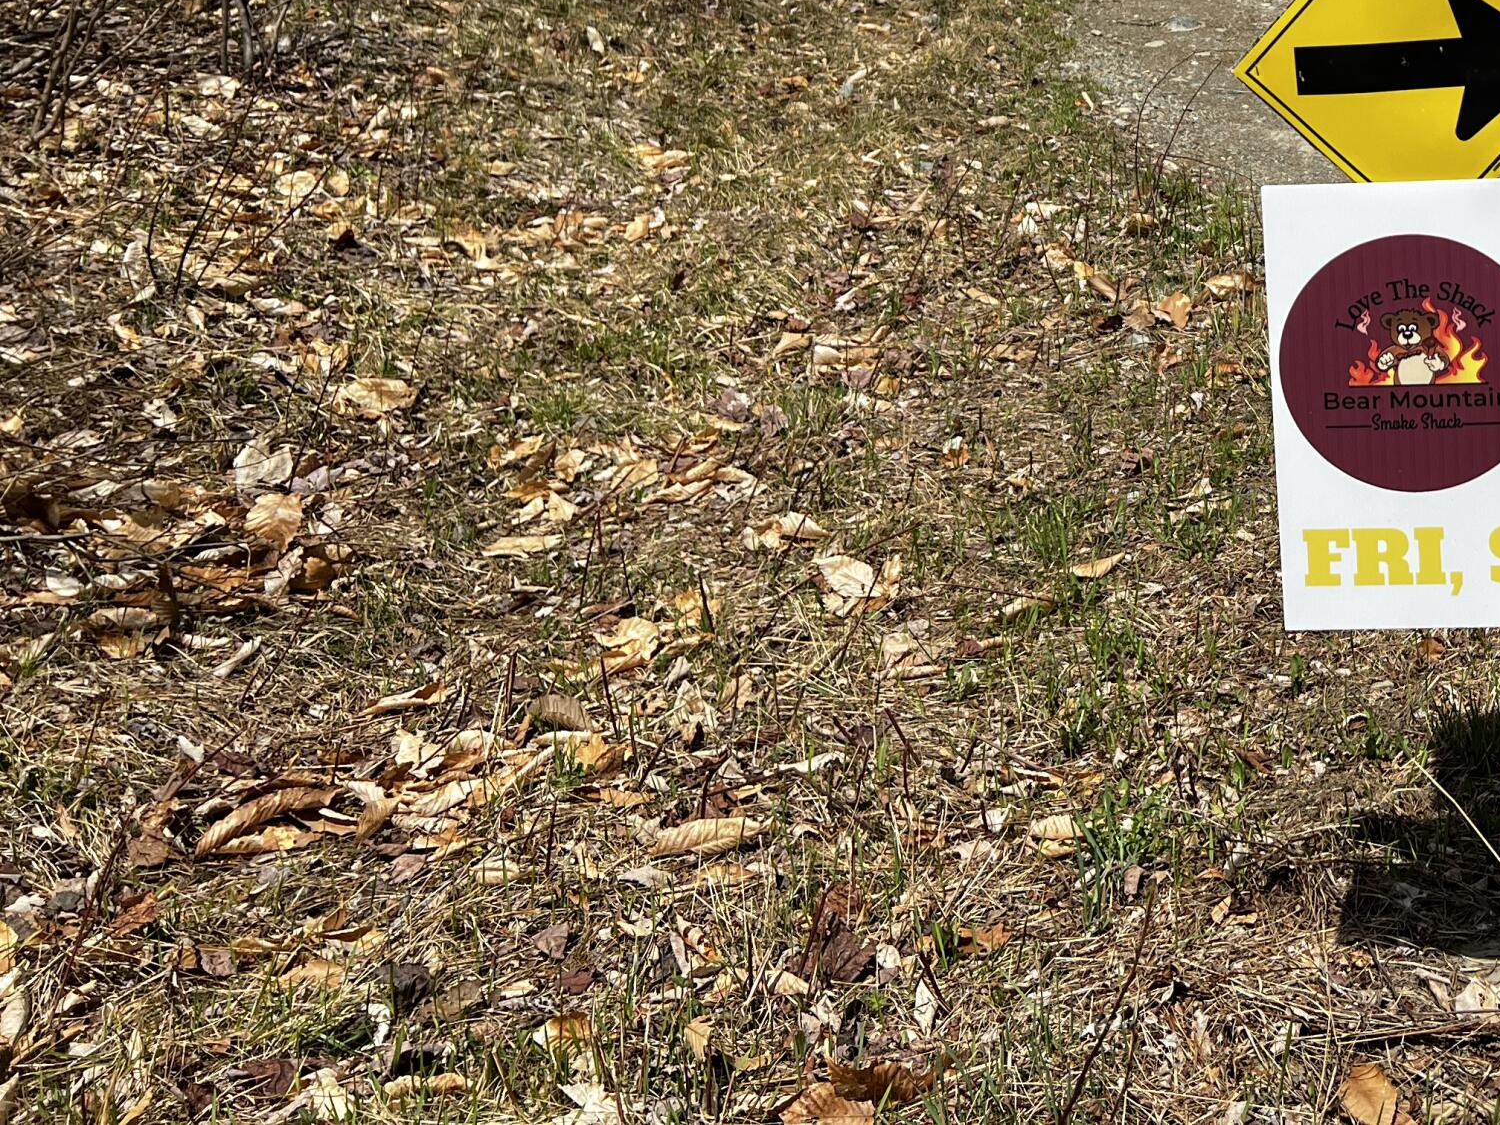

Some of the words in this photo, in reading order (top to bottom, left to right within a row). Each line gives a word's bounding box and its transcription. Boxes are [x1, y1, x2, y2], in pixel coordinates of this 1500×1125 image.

[1335, 289, 1384, 332] Love
[1386, 278, 1430, 302] The
[1436, 281, 1496, 328] Shack
[1323, 392, 1381, 411] Bear
[1371, 413, 1418, 432] Smoke
[1420, 413, 1464, 431] Shack
[1303, 527, 1464, 596] FRI,
